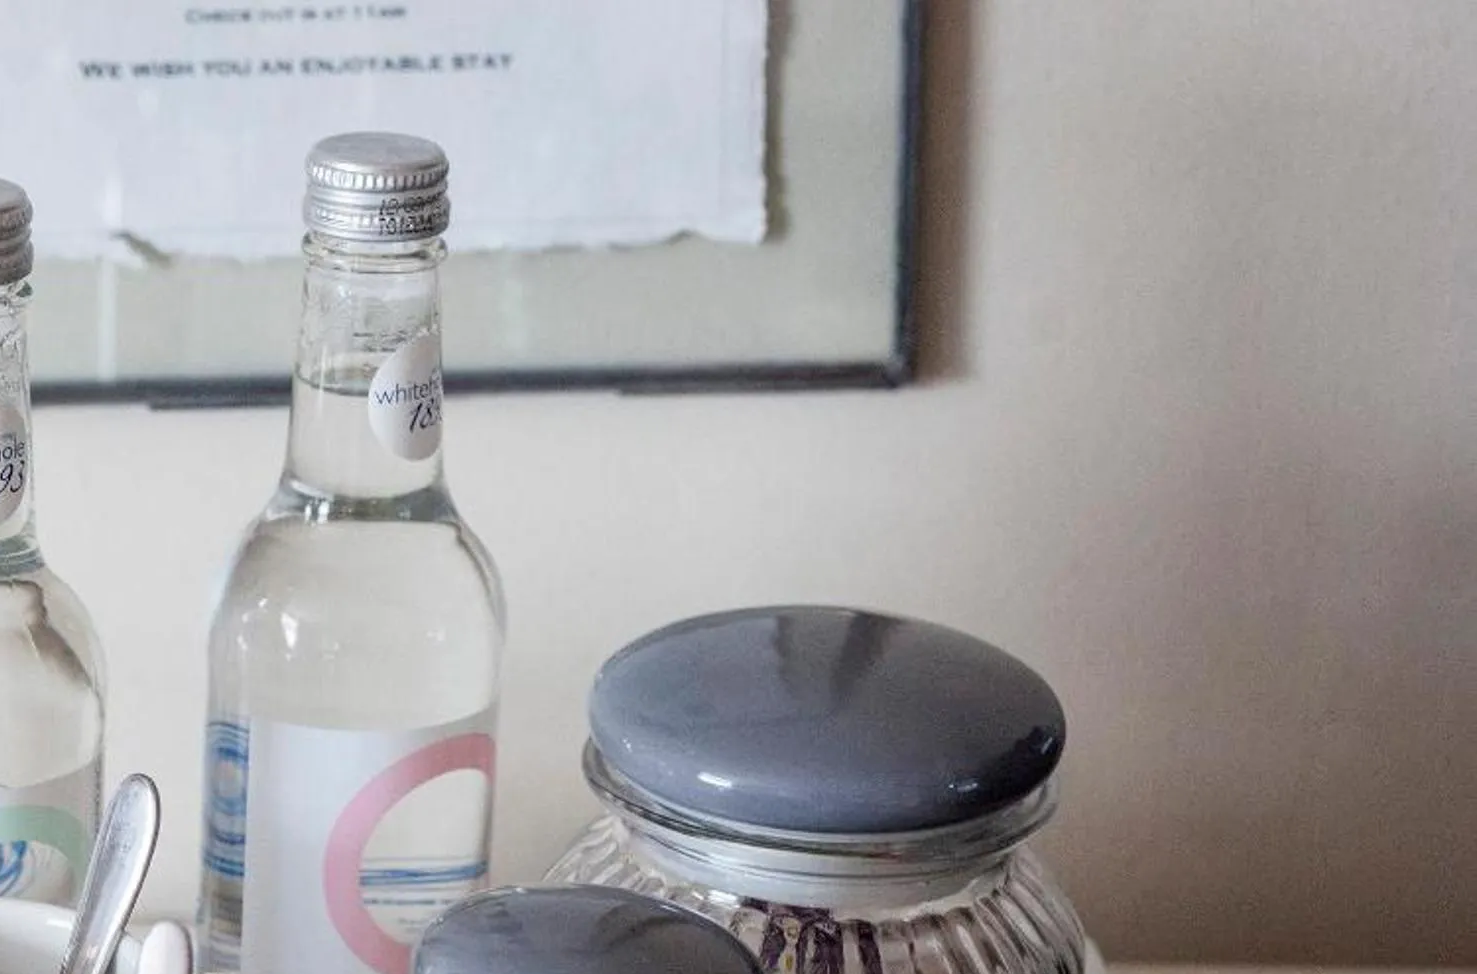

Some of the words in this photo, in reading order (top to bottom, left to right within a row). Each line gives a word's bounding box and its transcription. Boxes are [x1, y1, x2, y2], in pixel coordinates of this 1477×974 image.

[80, 60, 122, 79] WE
[132, 60, 195, 78] WISH
[202, 59, 252, 77] YOU
[259, 58, 293, 75] AN
[300, 54, 442, 75] ENJOYABLE
[451, 52, 513, 71] STAY
